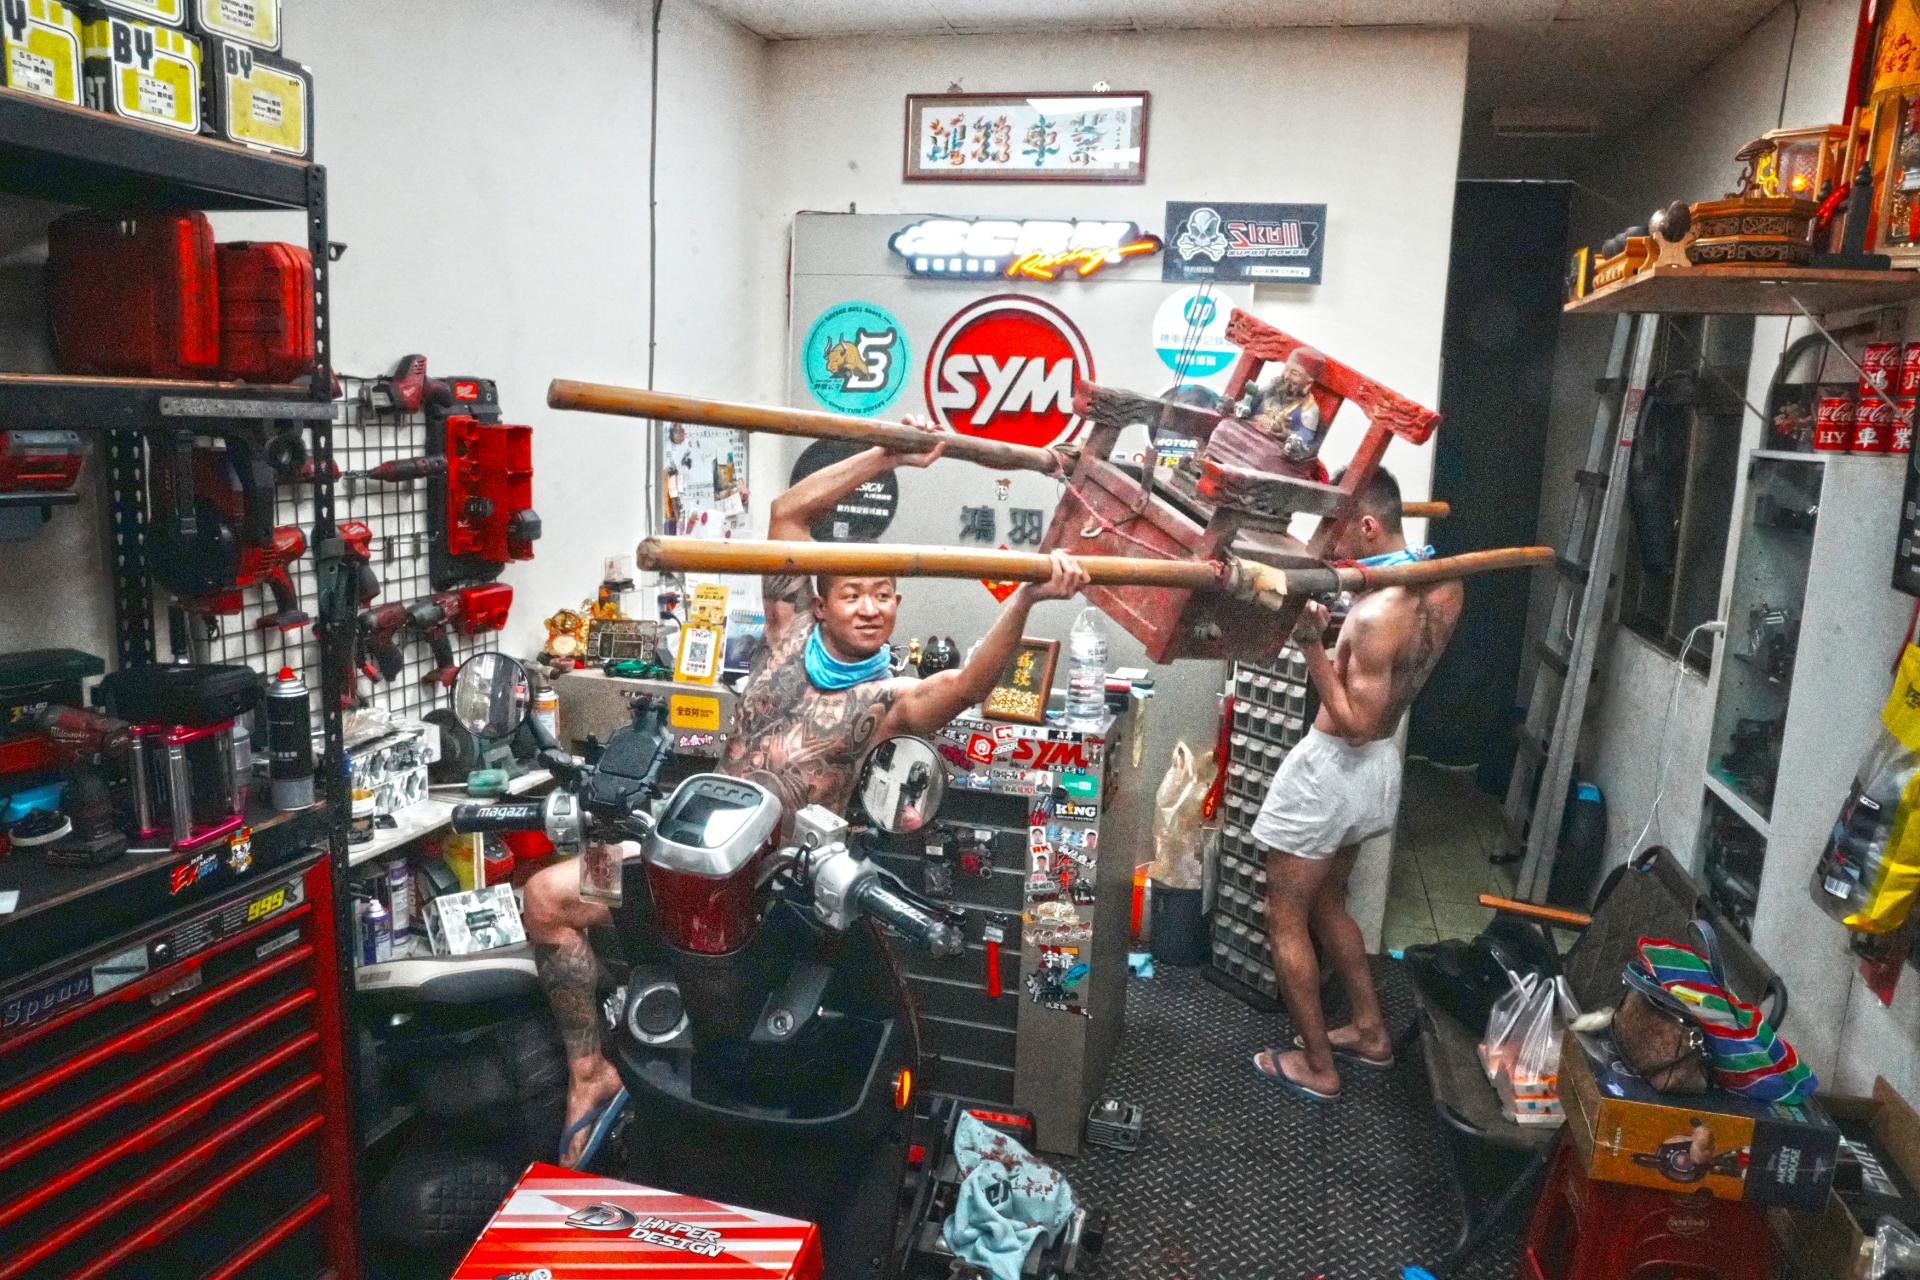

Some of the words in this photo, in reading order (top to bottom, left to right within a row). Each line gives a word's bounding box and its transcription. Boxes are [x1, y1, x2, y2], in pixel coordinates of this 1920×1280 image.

[112, 20, 154, 71] BY
[225, 44, 252, 80] BY
[1227, 222, 1300, 249] Skull
[939, 353, 1075, 426] SYM
[1819, 430, 1846, 444] HY
[856, 482, 885, 492] SIGN
[1011, 738, 1089, 769] SYM
[476, 806, 528, 820] magazi
[1055, 803, 1097, 818] KING
[248, 888, 286, 922] 999
[628, 1227, 726, 1258] DESIGN
[640, 1216, 722, 1244] HYPER
